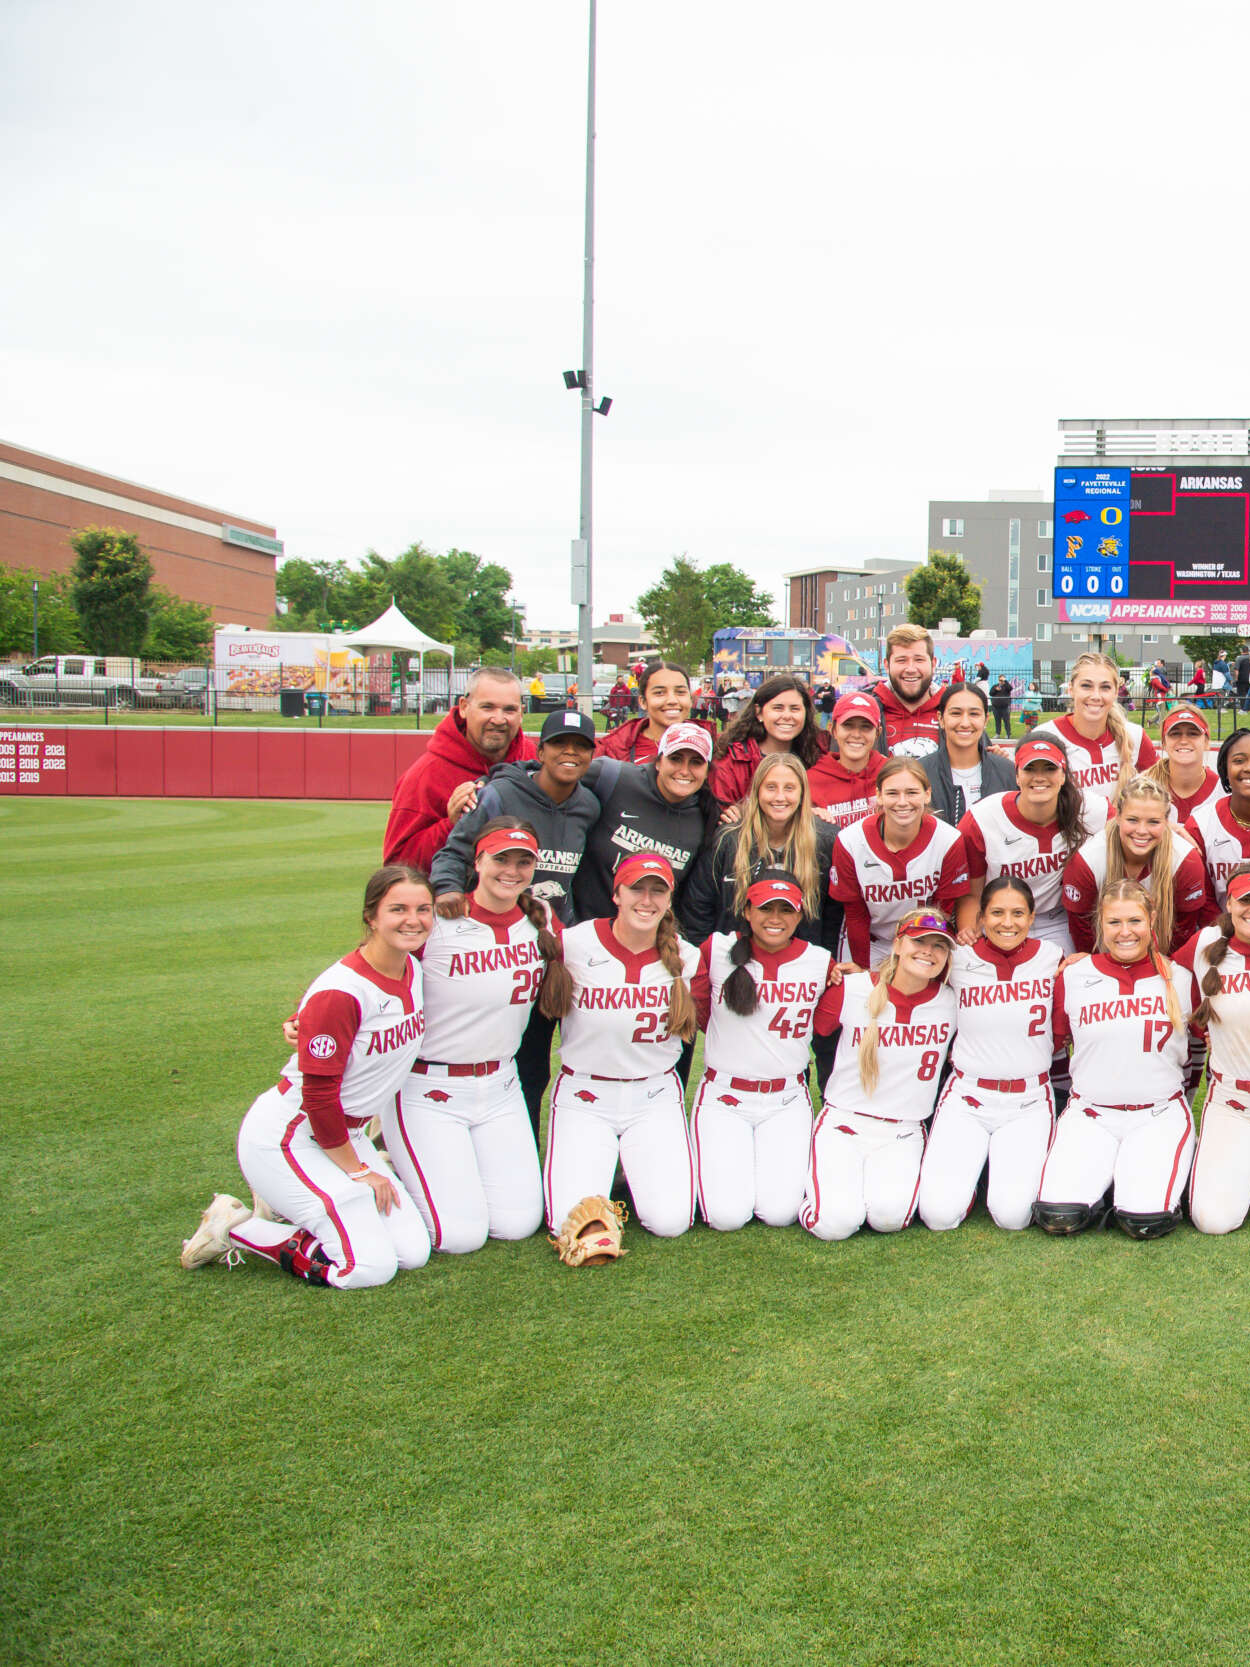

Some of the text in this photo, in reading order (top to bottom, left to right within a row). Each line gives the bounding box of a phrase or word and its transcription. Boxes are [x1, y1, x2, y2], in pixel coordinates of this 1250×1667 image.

[1085, 487, 1122, 495] REGIONAL
[1180, 476, 1243, 490] ARKANSAS
[1061, 575, 1074, 593] 0
[1086, 575, 1099, 593] 0
[1110, 575, 1123, 593] 0
[1221, 570, 1241, 578] TEXAS
[1070, 604, 1206, 618] NCAA APPEARANCES
[18, 744, 39, 756] 2017
[44, 744, 66, 756] 2021
[0, 758, 66, 770] 012 2018 2022
[0, 771, 16, 783] 013
[614, 823, 691, 863] ARKANSAS
[863, 870, 940, 902] RKANSAS
[448, 940, 544, 978] ARKANSA
[578, 985, 670, 1010] ARKANSA
[959, 978, 1051, 1010] ARKANSAS
[767, 1006, 812, 1040] 42
[1028, 1004, 1047, 1037] 2
[1079, 996, 1168, 1028] ARKANSA
[631, 1011, 672, 1044] 23
[851, 1022, 950, 1048] AKANSAS
[1143, 1019, 1174, 1053] 17
[309, 1034, 337, 1059] SEC
[917, 1050, 940, 1082] 8
